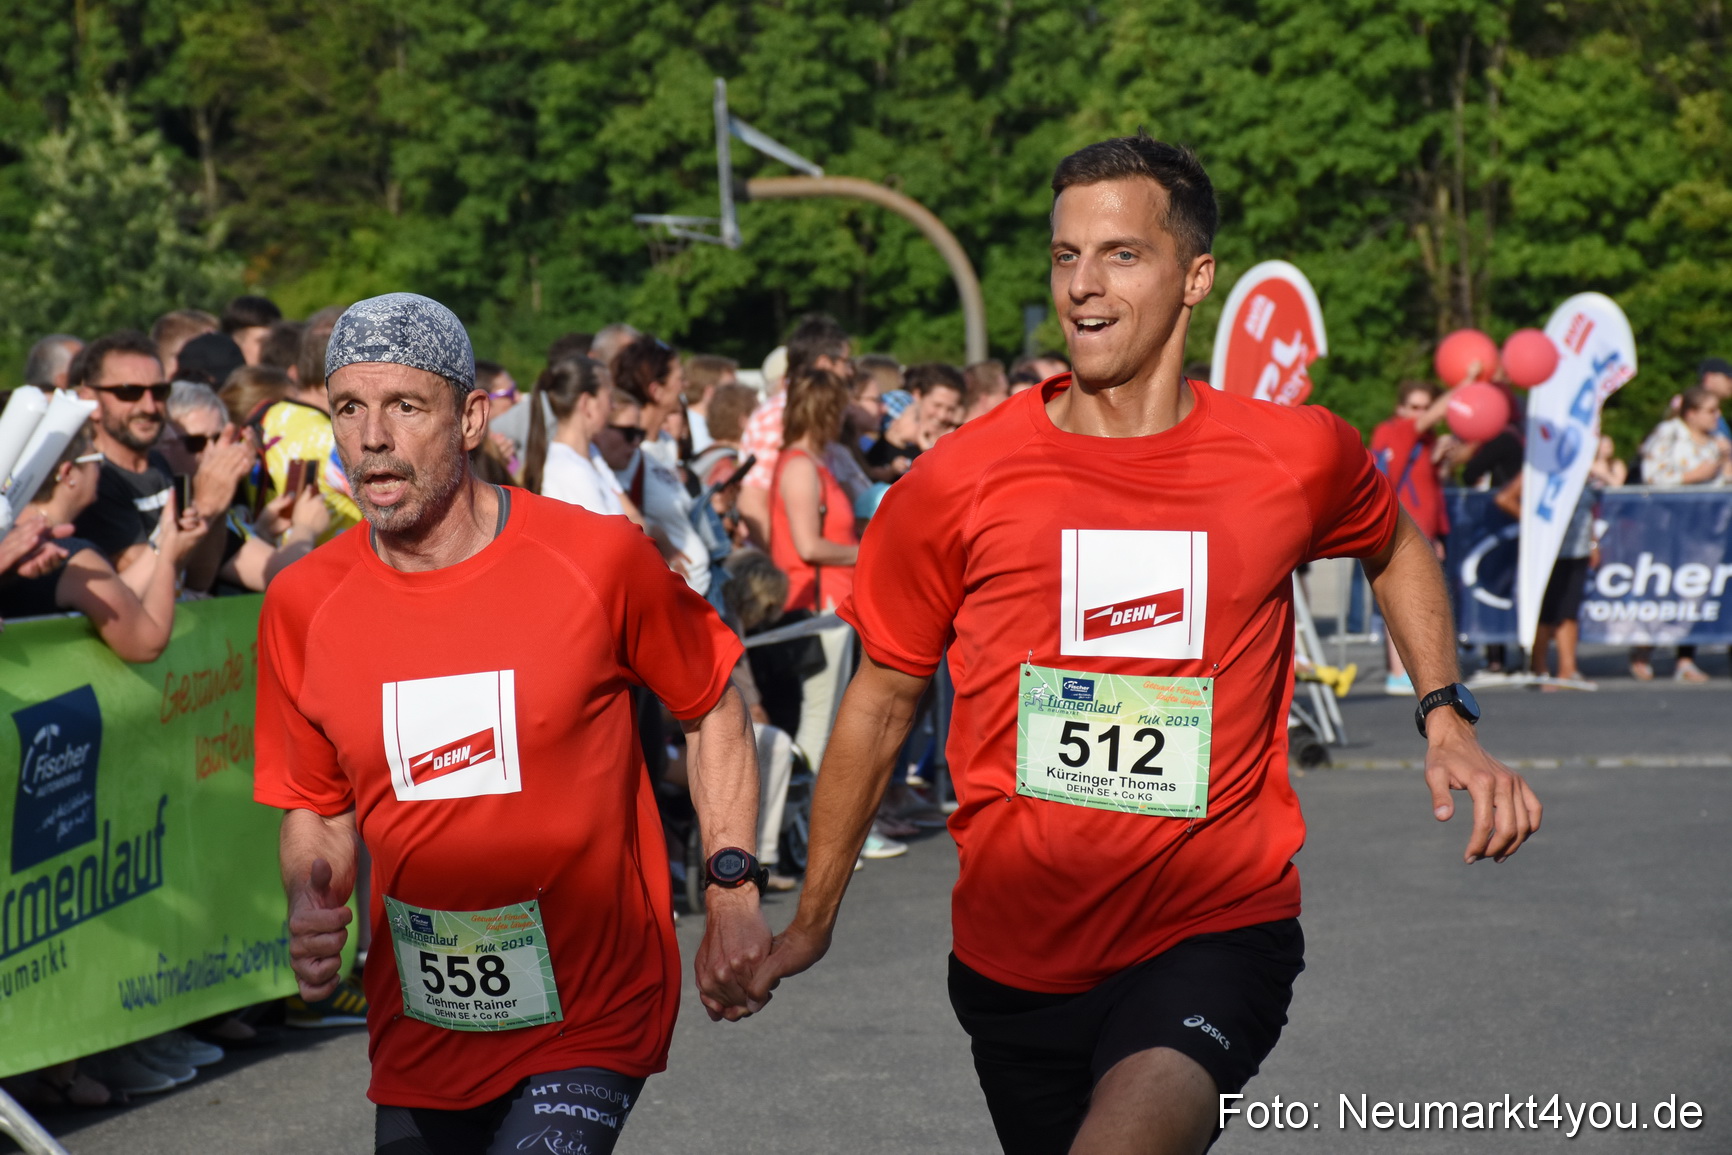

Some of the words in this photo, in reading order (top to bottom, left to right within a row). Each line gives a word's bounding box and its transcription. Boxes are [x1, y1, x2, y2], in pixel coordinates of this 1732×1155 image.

[1594, 551, 1732, 598] cher
[1110, 603, 1157, 626] DEHN
[1584, 600, 1721, 622] OMOBILE
[1048, 694, 1123, 715] firmenlauf
[1137, 714, 1161, 726] run
[1165, 715, 1200, 727] 2019
[433, 744, 471, 771] DEHN
[1058, 720, 1166, 776] 512
[33, 743, 91, 784] Fischer
[1046, 766, 1115, 788] Kürzinger
[1119, 776, 1176, 792] Thomas
[1066, 783, 1094, 795] DEHN
[1097, 787, 1110, 797] SE
[1121, 791, 1135, 800] Co
[1137, 792, 1153, 801] KG
[2, 793, 168, 952] rmenlauf
[405, 925, 458, 946] firmenlauf
[475, 943, 496, 953] run
[502, 935, 533, 951] 2019
[2, 939, 68, 998] umarkt
[419, 950, 511, 998] 558
[425, 993, 470, 1011] Ziehmer
[474, 999, 518, 1011] Rainer
[434, 1008, 457, 1019] DEHN
[459, 1010, 470, 1020] SE
[480, 1010, 492, 1020] Co
[495, 1010, 509, 1019] KG
[1200, 1022, 1231, 1051] asics
[531, 1083, 561, 1097] HT
[566, 1083, 623, 1104] GROUP
[533, 1102, 618, 1129] RANDOW
